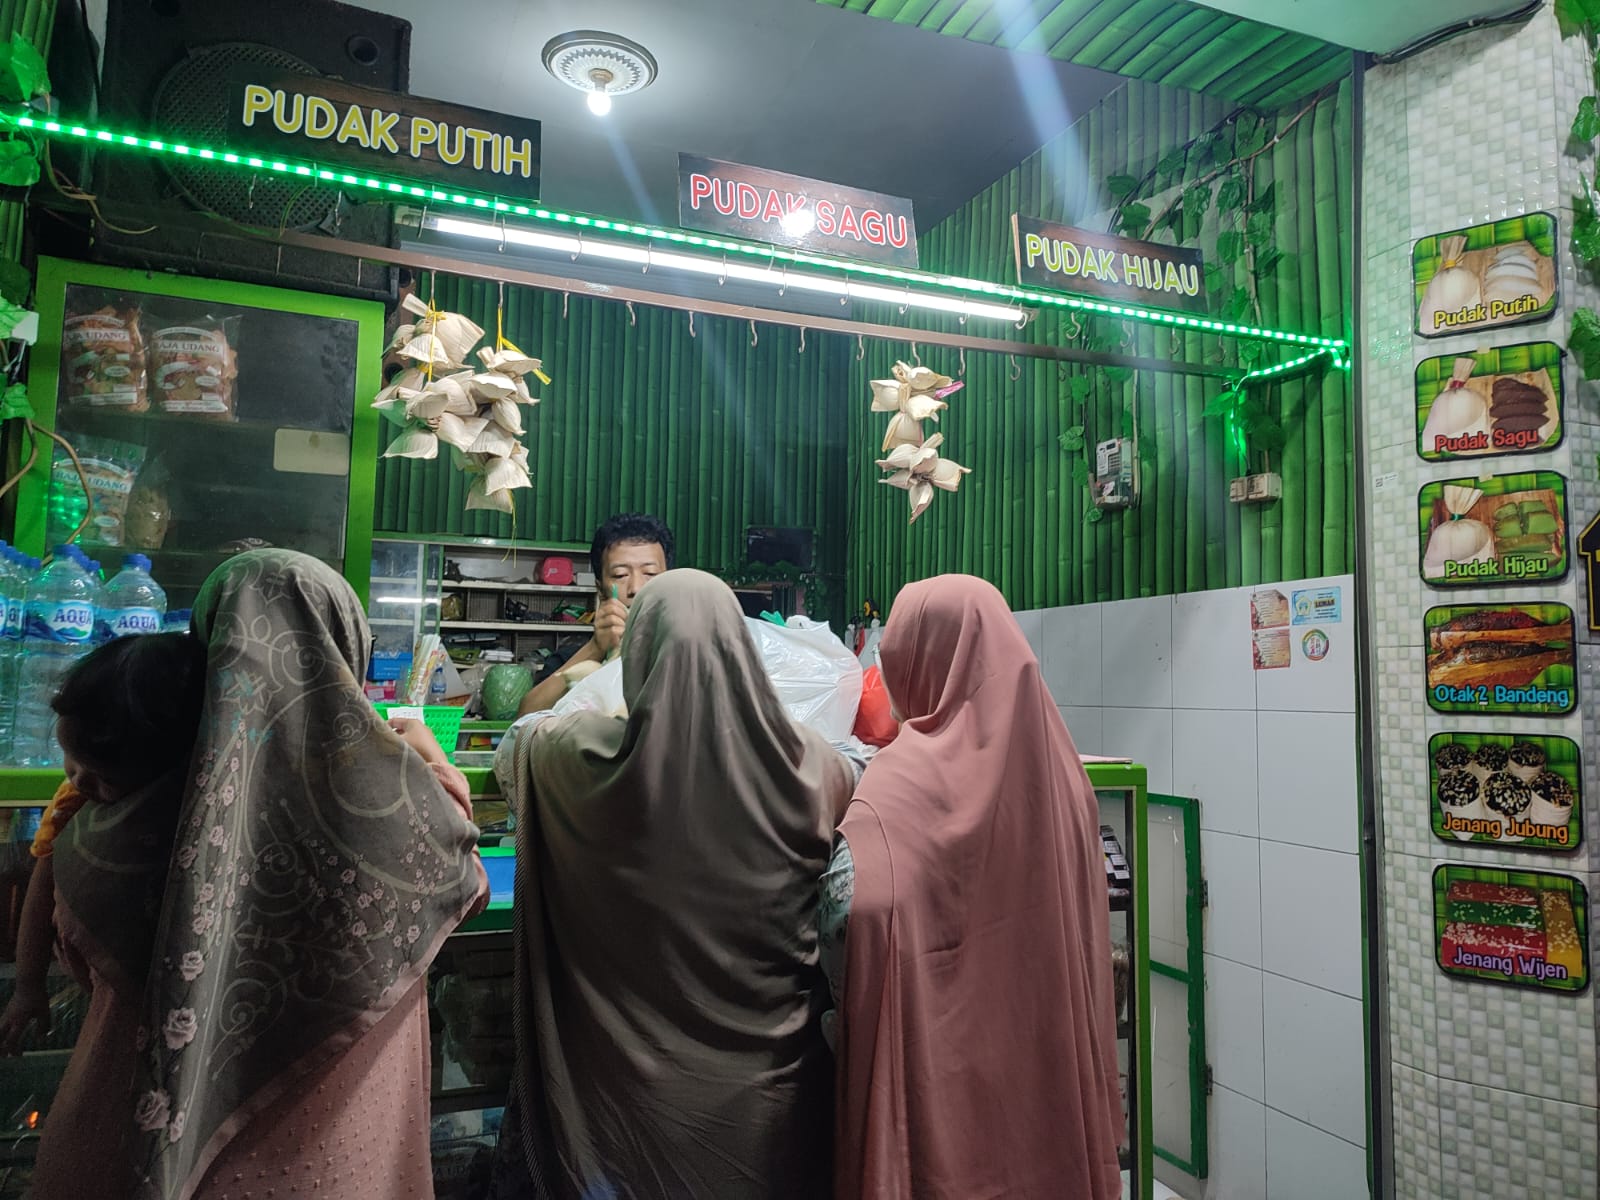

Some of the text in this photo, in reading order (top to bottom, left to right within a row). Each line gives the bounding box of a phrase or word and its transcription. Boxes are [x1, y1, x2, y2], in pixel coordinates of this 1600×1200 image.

[243, 84, 531, 177] PUDAK PUTIH
[816, 200, 907, 248] SAGU
[1026, 233, 1199, 296] PUDAK HIJAU
[1434, 294, 1539, 329] Pudak Putih
[183, 342, 220, 353] UDANG
[1435, 429, 1539, 453] Pudak Sagu
[1444, 555, 1548, 578] Pudak Hijau
[54, 608, 92, 626] AQUA
[118, 615, 156, 631] AQUA
[1495, 685, 1569, 707] Bandeng
[1443, 812, 1568, 844] Jenang Jubung
[1454, 946, 1567, 981] Jenang Wijen
